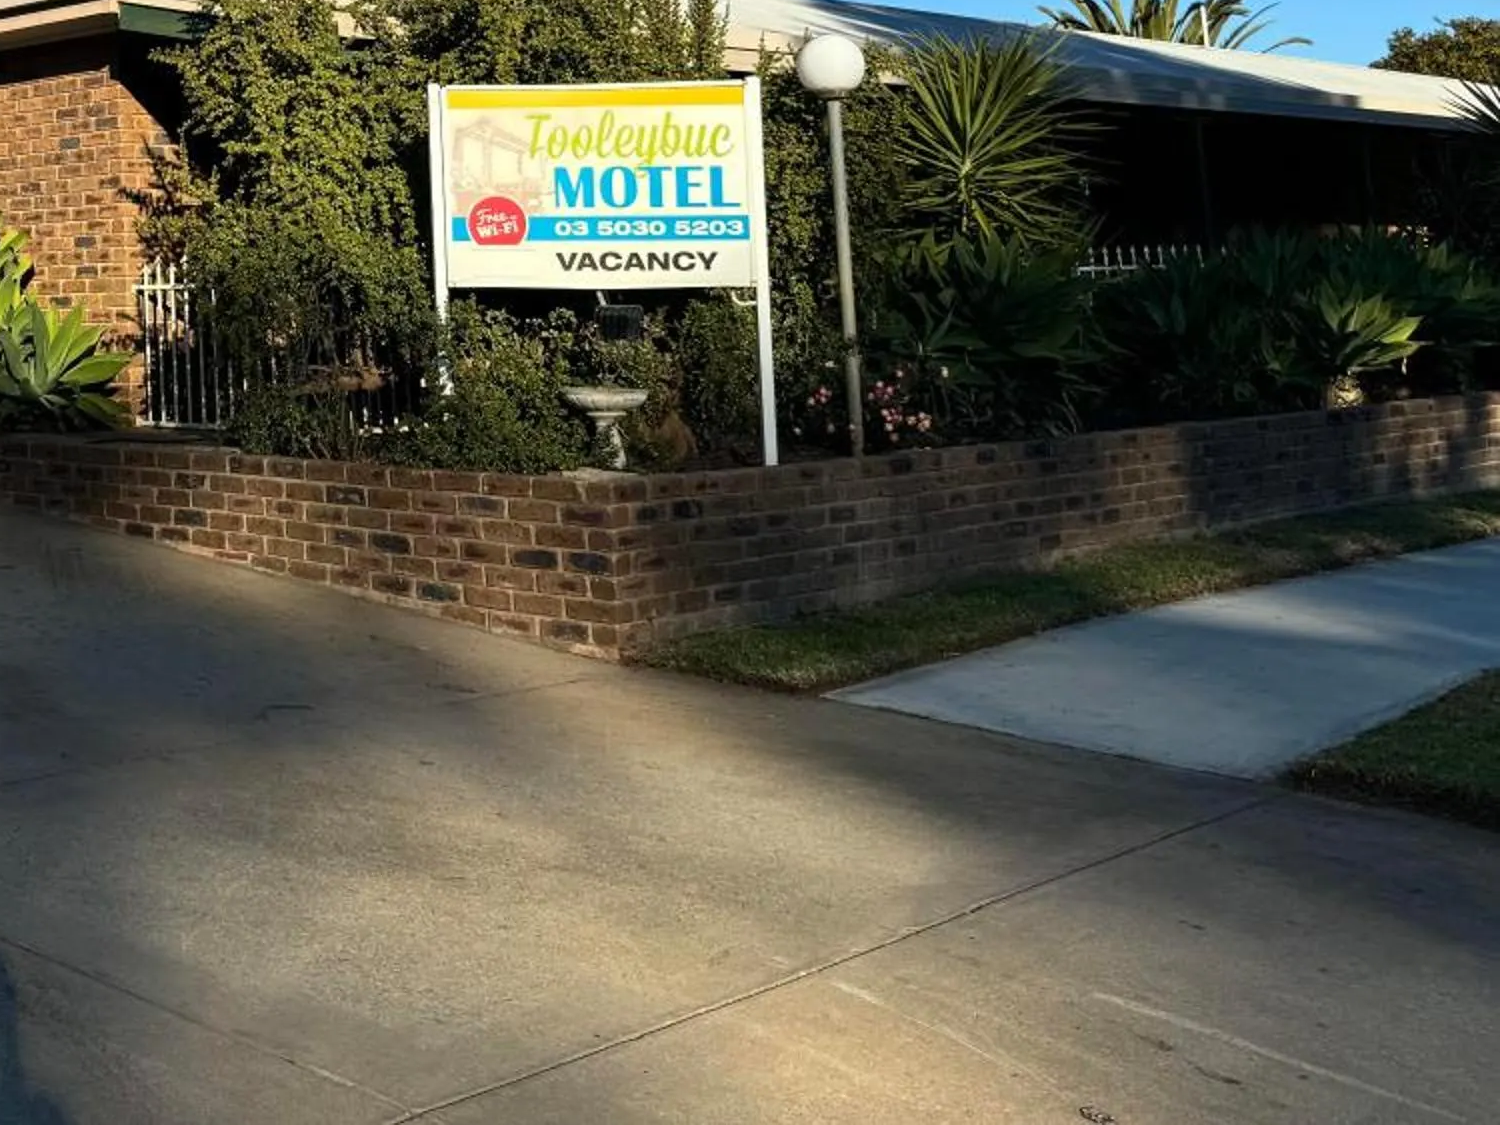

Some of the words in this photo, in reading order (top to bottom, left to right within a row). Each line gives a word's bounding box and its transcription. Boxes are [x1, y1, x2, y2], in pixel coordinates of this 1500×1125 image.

[523, 110, 733, 178] Tooleybuc
[554, 165, 741, 209] MOTEL
[554, 220, 589, 236] 03
[596, 220, 667, 236] 5030
[674, 219, 744, 236] 5203
[555, 250, 718, 272] VACANCY
